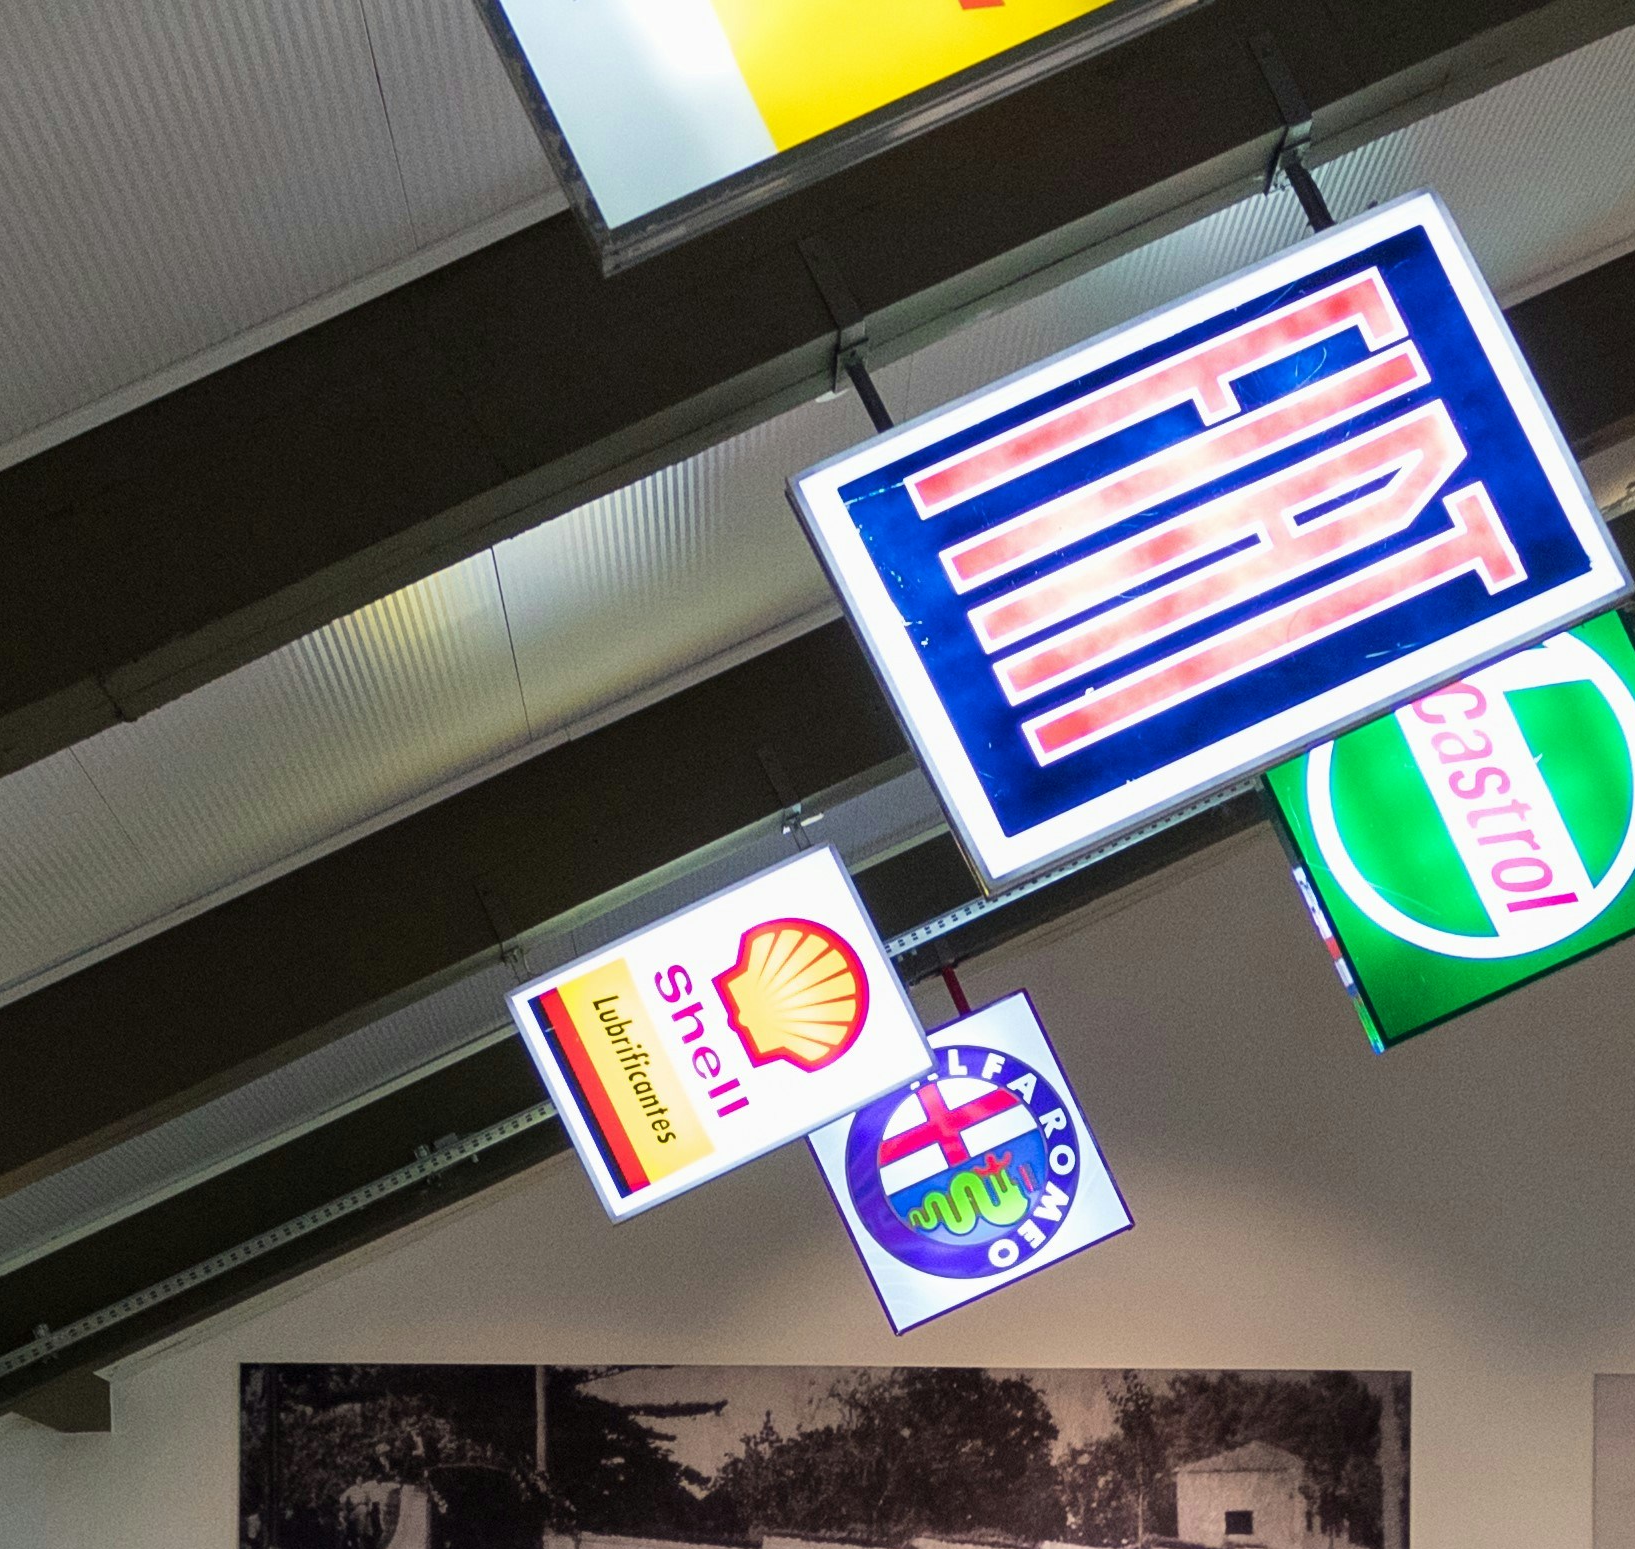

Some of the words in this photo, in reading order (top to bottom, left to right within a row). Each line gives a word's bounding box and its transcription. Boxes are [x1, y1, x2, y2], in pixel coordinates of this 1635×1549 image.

[904, 266, 1527, 767] FIAT
[1411, 680, 1579, 913] Castrol
[592, 995, 677, 1144] Lubrificantes
[654, 964, 750, 1119] Shell
[910, 1048, 1038, 1105] LFA
[987, 1107, 1076, 1268] ROMEO
